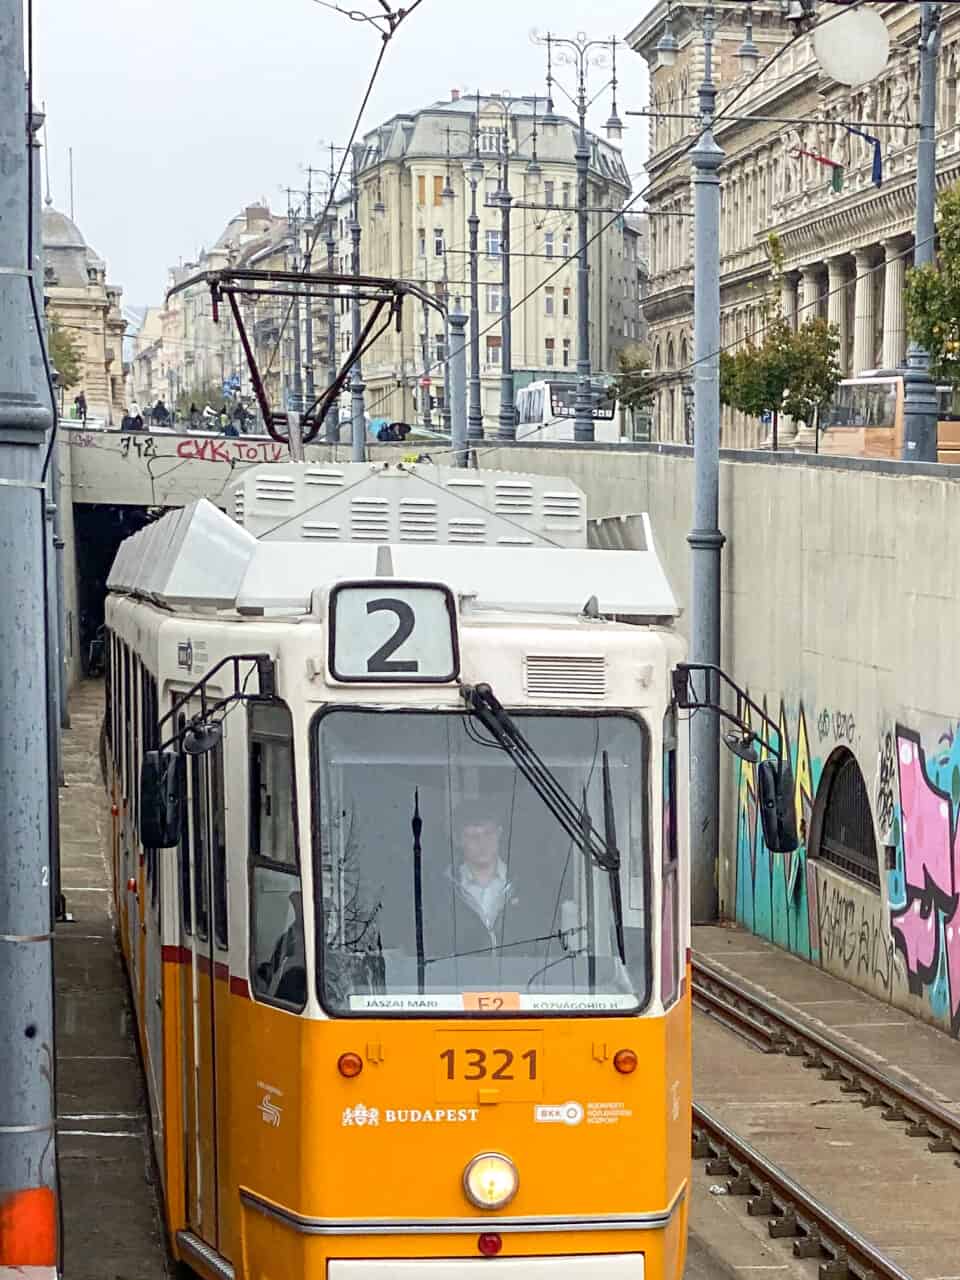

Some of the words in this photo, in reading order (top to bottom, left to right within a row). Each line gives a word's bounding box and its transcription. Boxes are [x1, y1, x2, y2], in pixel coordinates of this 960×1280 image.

[366, 598, 419, 673] 2
[440, 1048, 537, 1080] 1321
[385, 1108, 480, 1123] BUDAPEST
